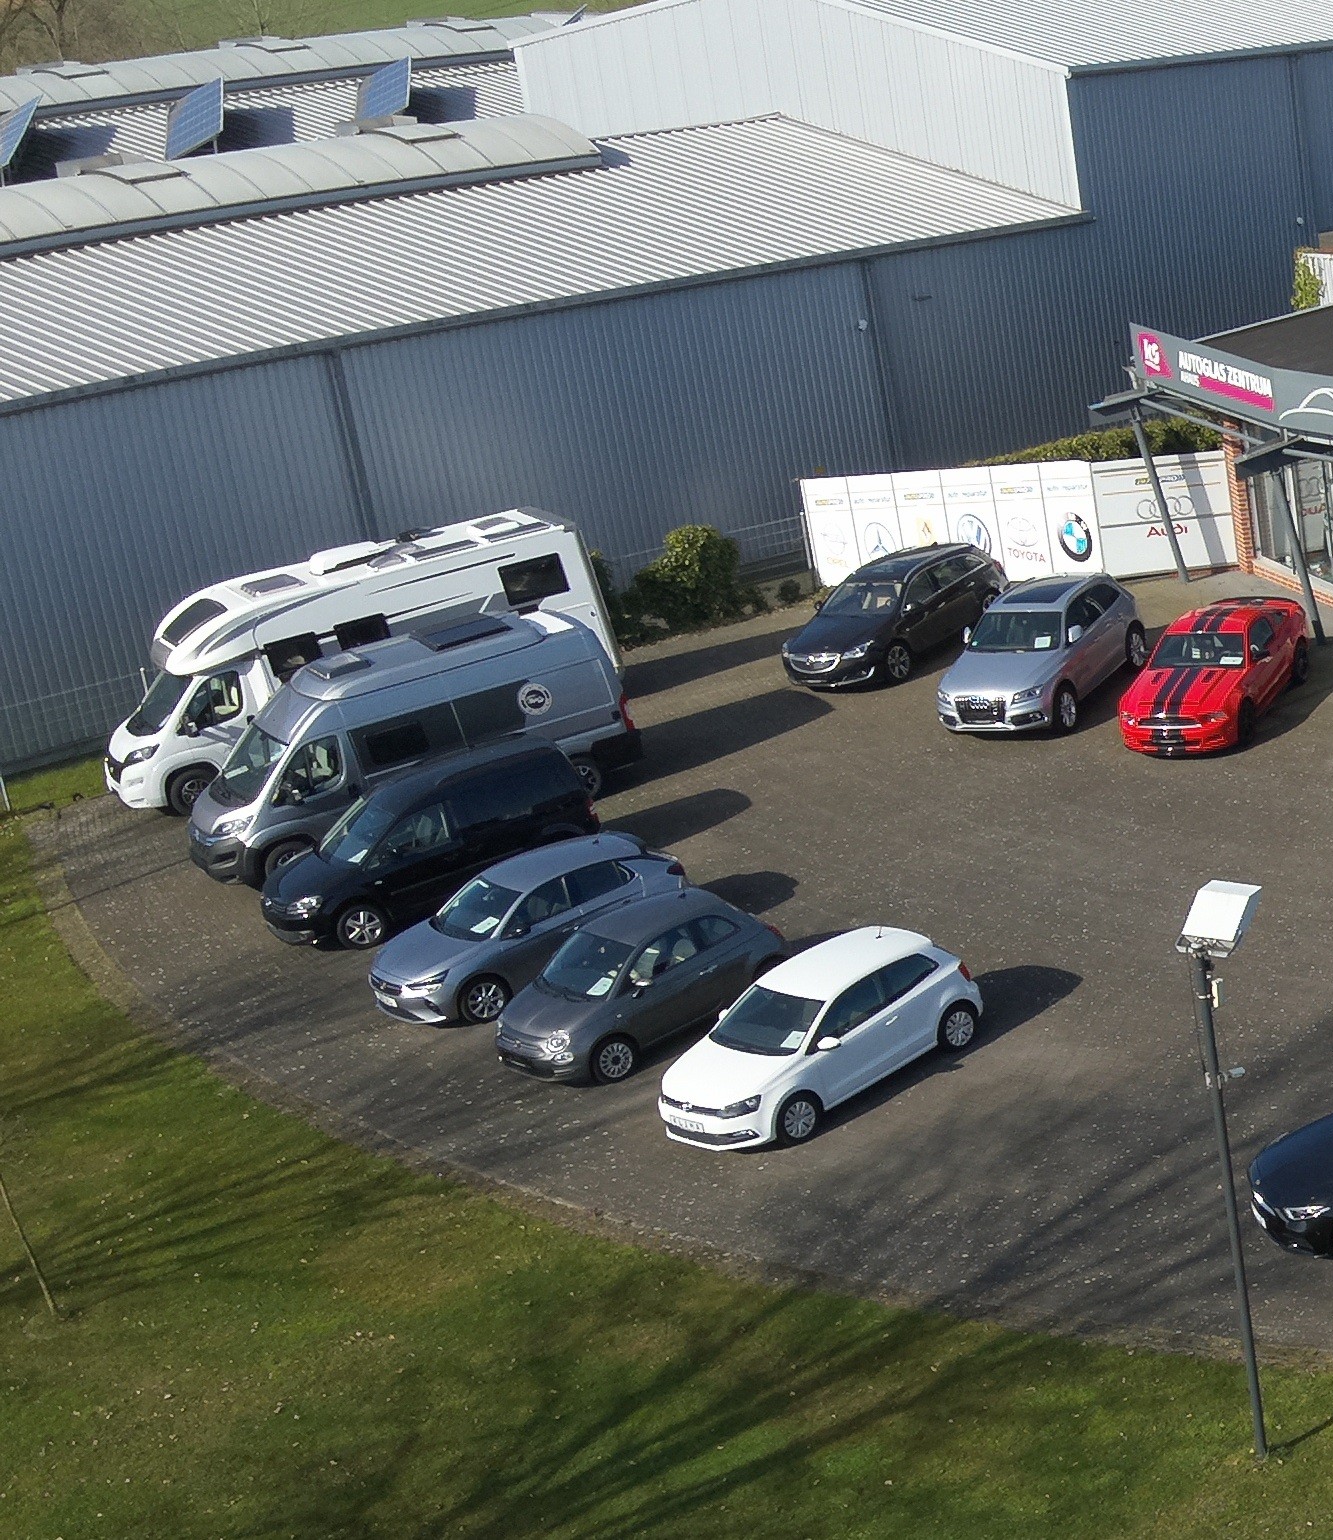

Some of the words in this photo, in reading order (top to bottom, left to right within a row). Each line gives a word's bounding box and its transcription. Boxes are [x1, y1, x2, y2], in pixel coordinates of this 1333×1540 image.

[1178, 350, 1227, 383] AUTOGLAS
[1227, 364, 1273, 398] ZENTRUM
[1007, 547, 1046, 563] TOYOTA
